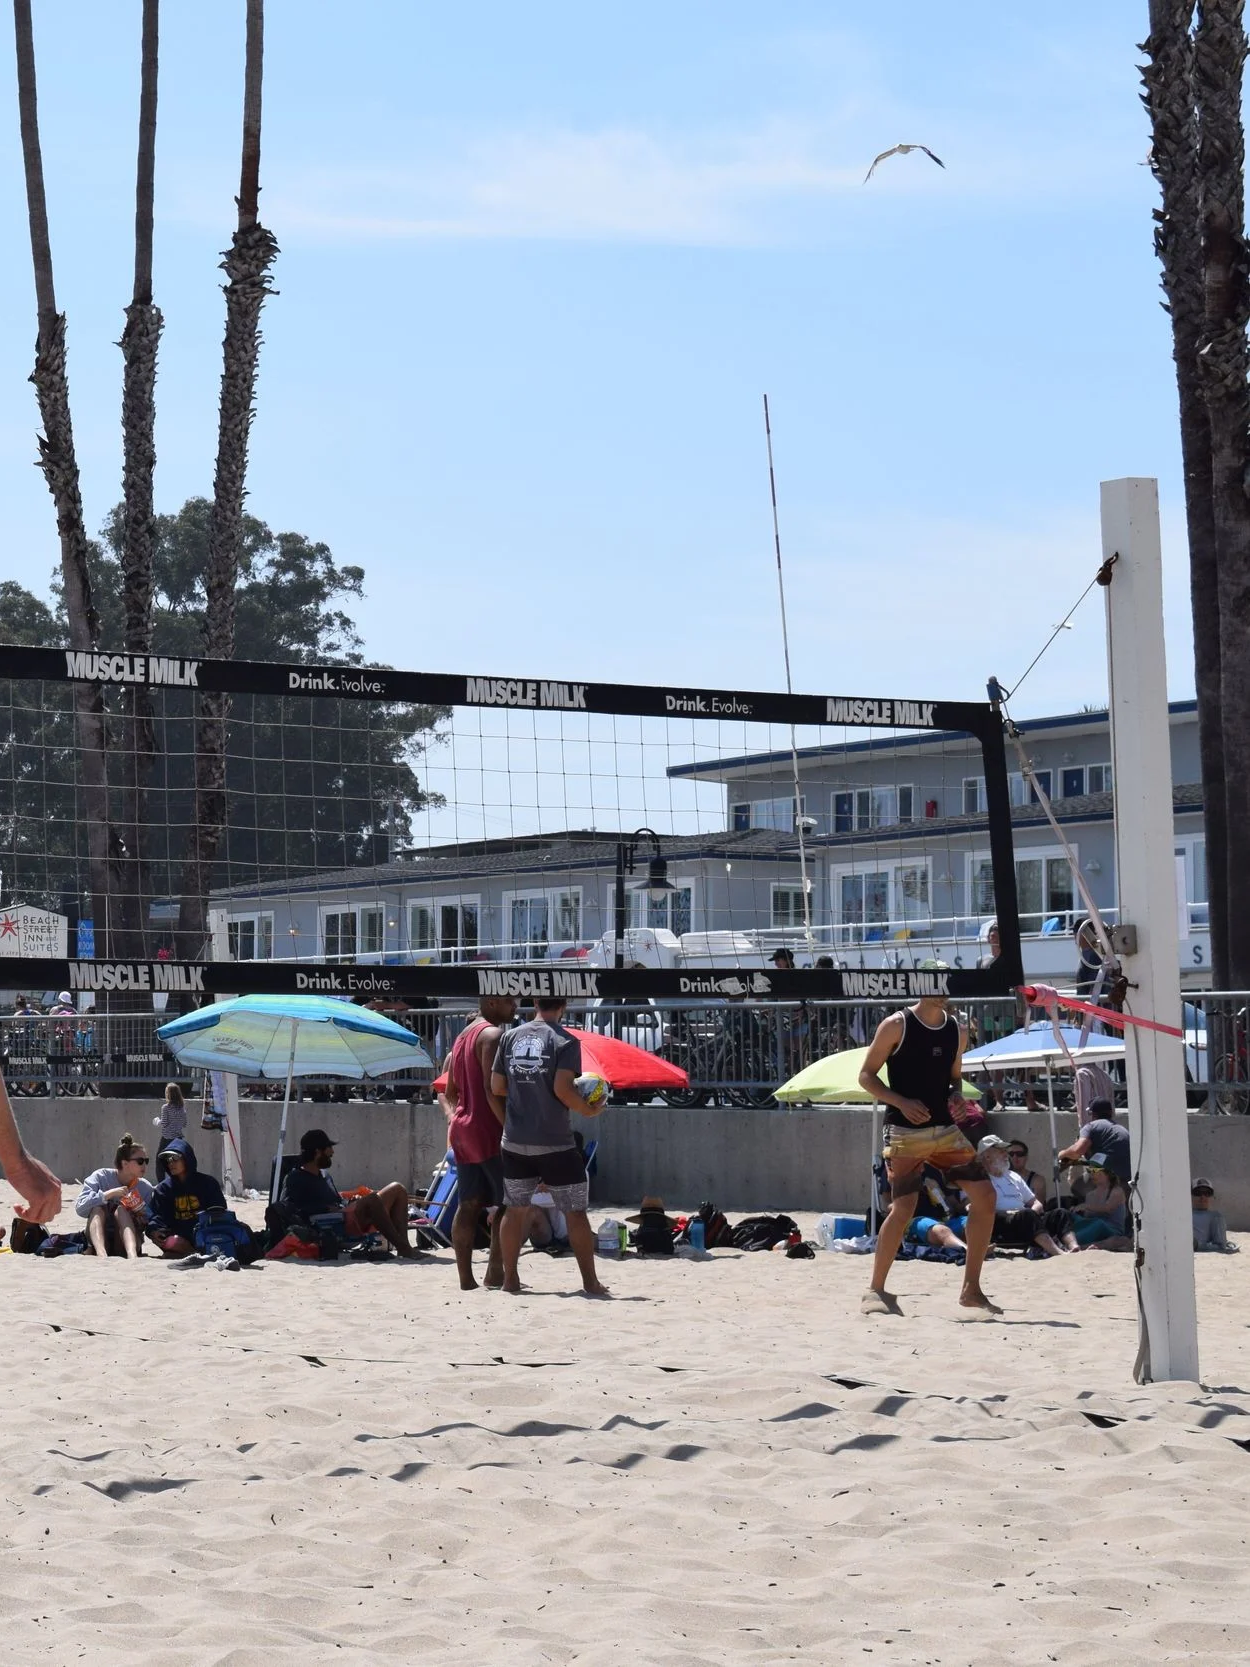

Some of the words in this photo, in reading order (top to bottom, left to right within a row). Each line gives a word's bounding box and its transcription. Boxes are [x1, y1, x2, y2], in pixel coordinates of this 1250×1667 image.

[66, 651, 145, 682] MUSCLE
[149, 655, 198, 686] MILK
[289, 673, 339, 689] Drink.
[467, 678, 536, 705] MUSCLE
[540, 682, 586, 707] MILK
[666, 696, 709, 712] Drink.
[827, 699, 890, 723] MUSCLE
[894, 701, 934, 726] MILK
[23, 915, 59, 925] BEACH
[23, 925, 59, 934] STREET
[24, 934, 43, 942] INN
[23, 942, 59, 952] SUITES
[69, 963, 150, 990] MUSCLE
[153, 964, 204, 990] MILK
[296, 973, 346, 989] Drink.
[477, 970, 550, 996] MUSCLE
[552, 972, 600, 996] MILK
[842, 973, 909, 996] MUSCLE
[913, 973, 951, 995] MILK
[8, 1056, 32, 1065] MUSCLE
